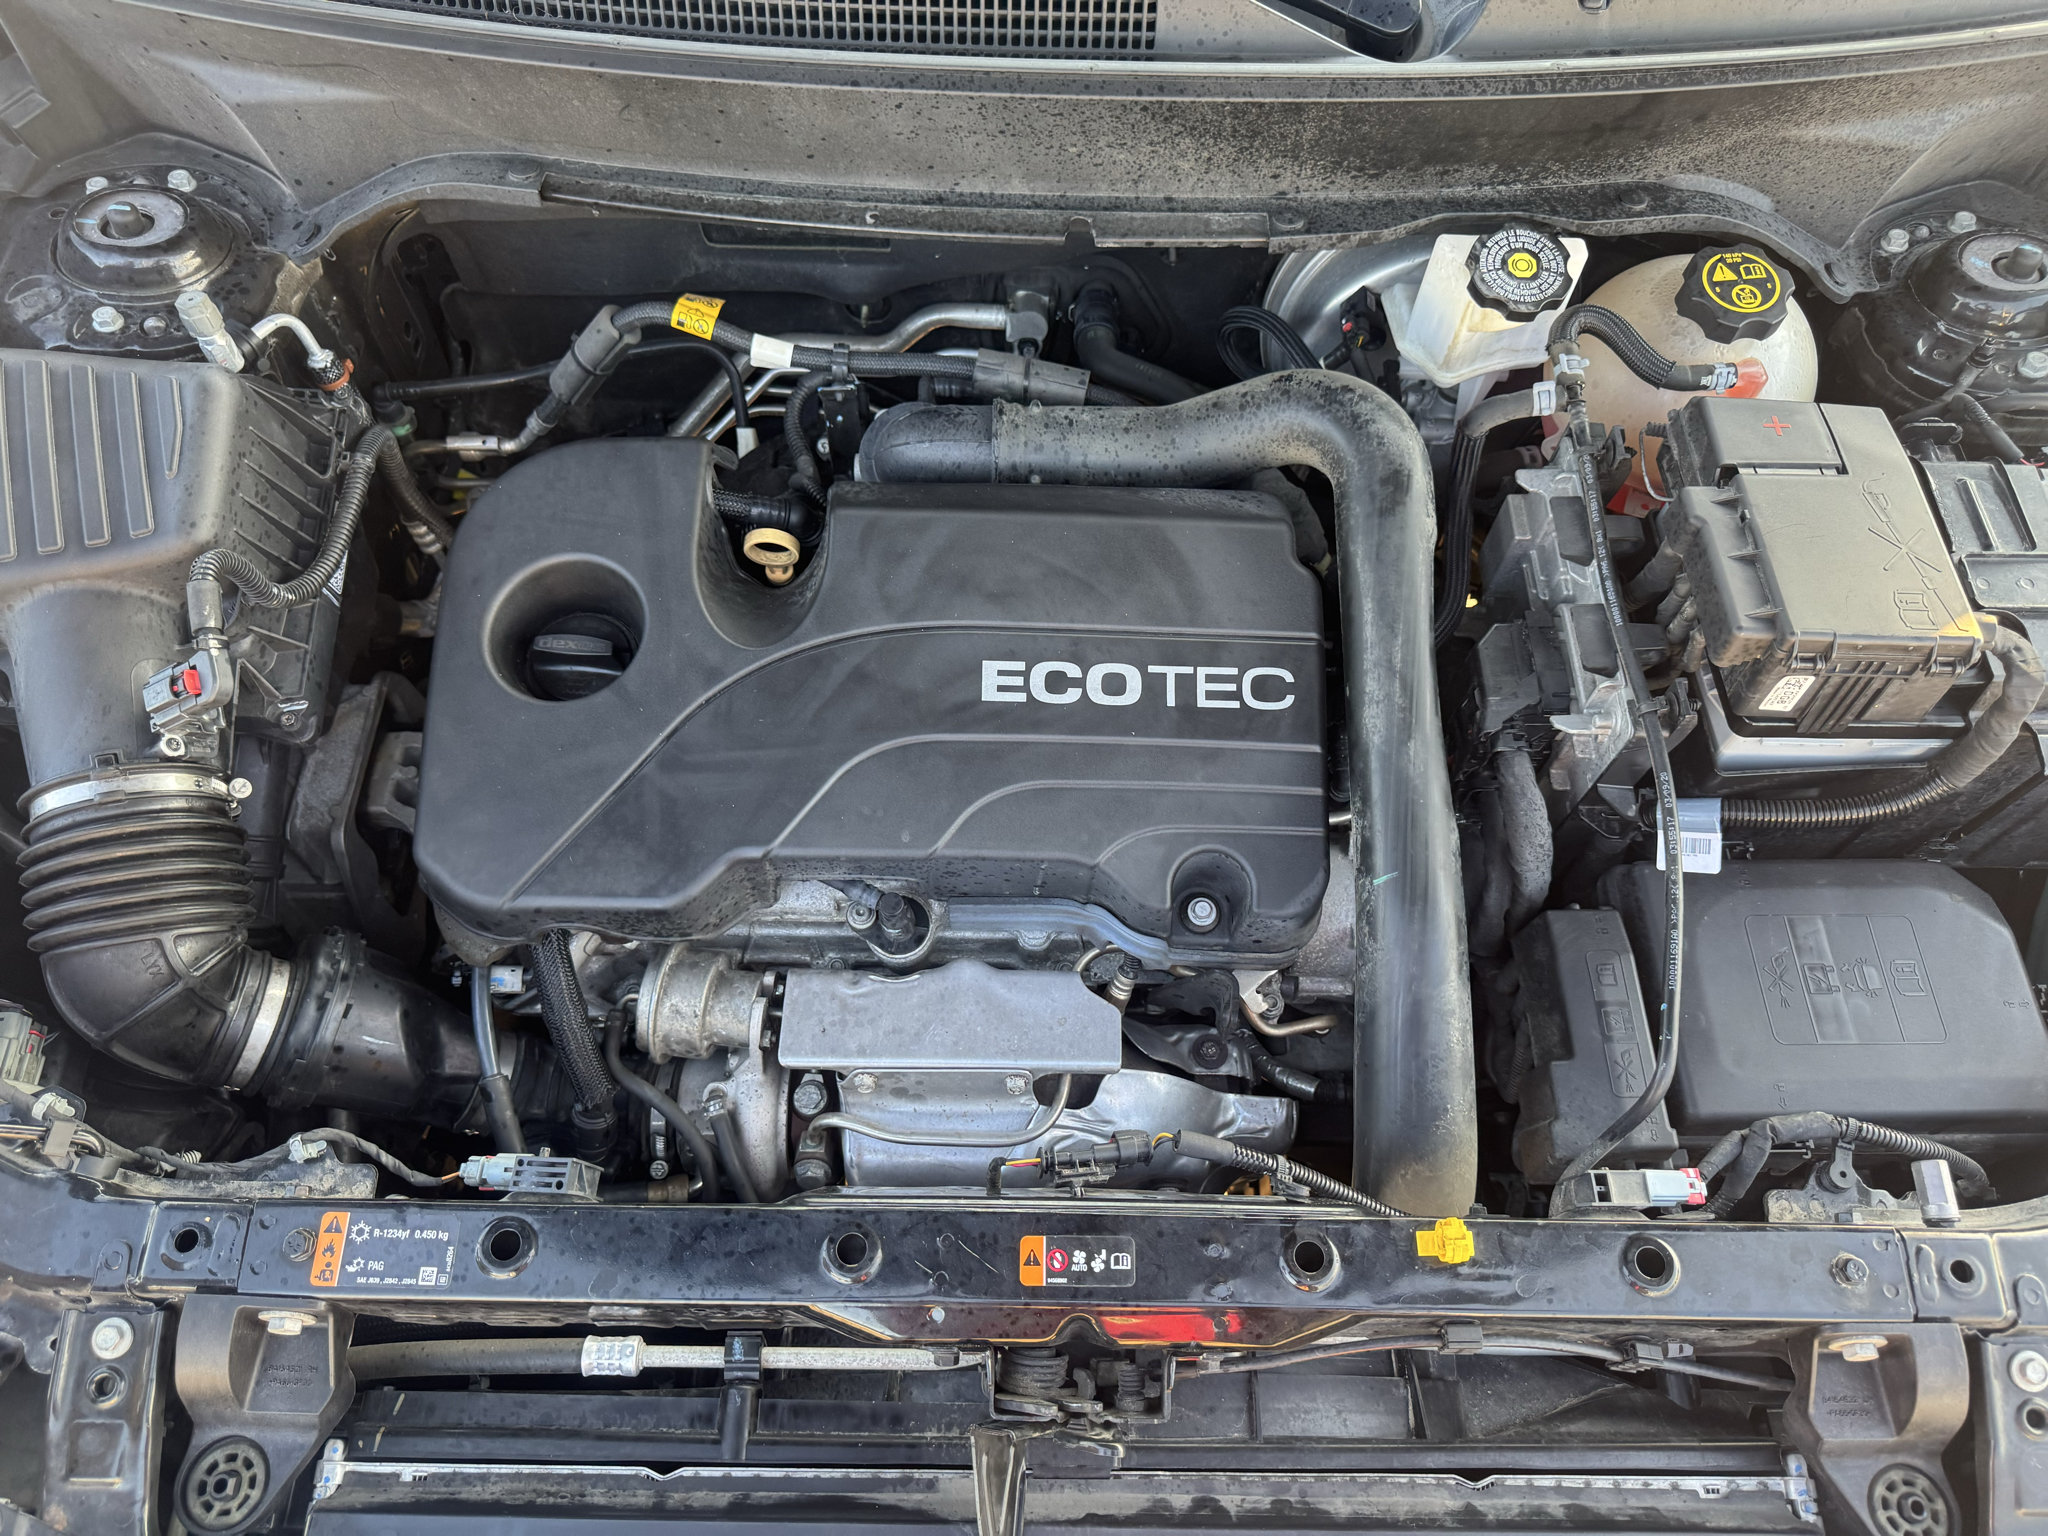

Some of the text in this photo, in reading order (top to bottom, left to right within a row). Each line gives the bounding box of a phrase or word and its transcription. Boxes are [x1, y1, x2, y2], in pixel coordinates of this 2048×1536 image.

[1516, 229, 1540, 240] BOUCHON
[1540, 236, 1555, 250] AVANT
[1582, 454, 1594, 484] 03/09/2
[981, 660, 1296, 711] ECOTEC
[1660, 772, 1673, 808] 03/09/20
[1666, 816, 1678, 855] 03:55:17
[373, 1229, 449, 1241] R-1234yf 0.450 kg
[367, 1260, 385, 1271] PAG
[1071, 1264, 1088, 1272] AUTO
